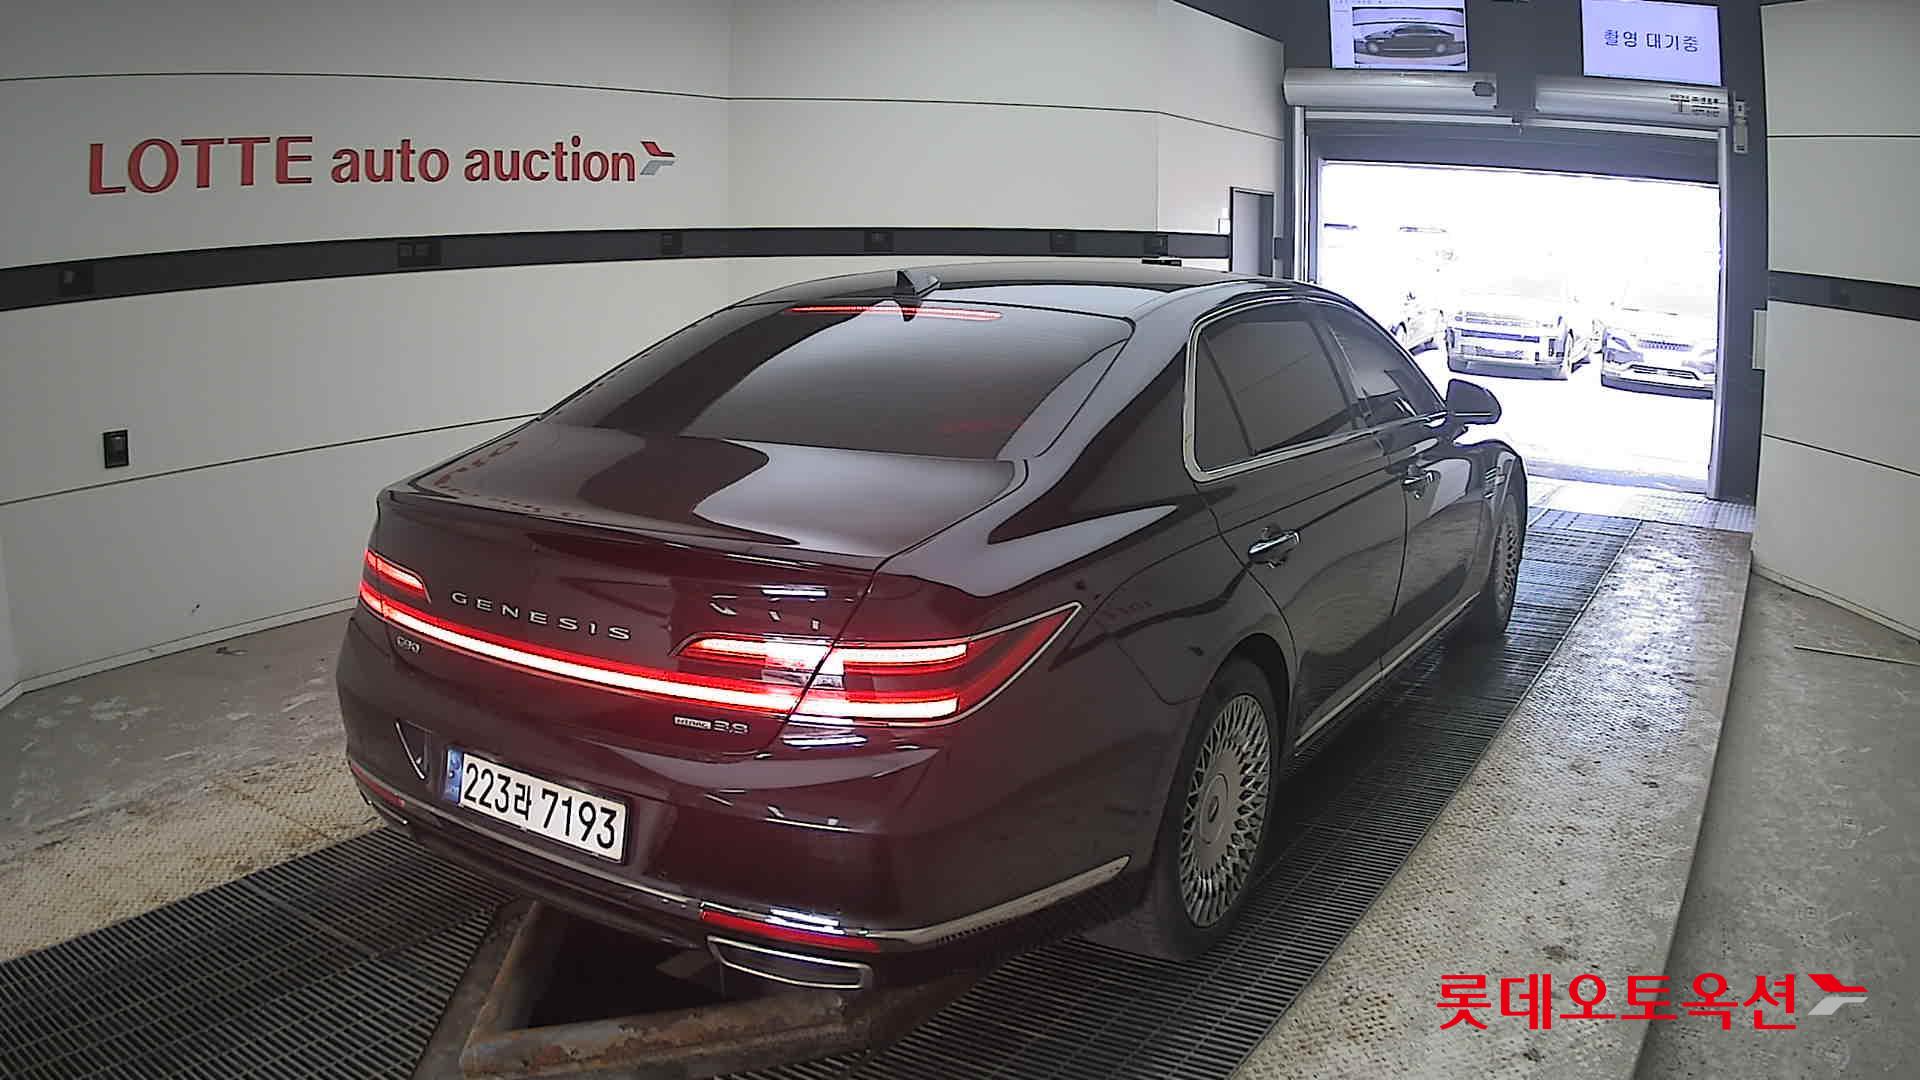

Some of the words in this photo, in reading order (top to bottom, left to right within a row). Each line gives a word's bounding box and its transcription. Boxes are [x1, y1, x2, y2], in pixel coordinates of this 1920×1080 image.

[1646, 32, 1699, 53] 대기중
[88, 135, 313, 196] LOTTE
[330, 138, 450, 184] auto
[463, 135, 637, 183] auction
[451, 592, 632, 641] GENESIS
[463, 762, 532, 821] 223라
[541, 788, 618, 849] 7193
